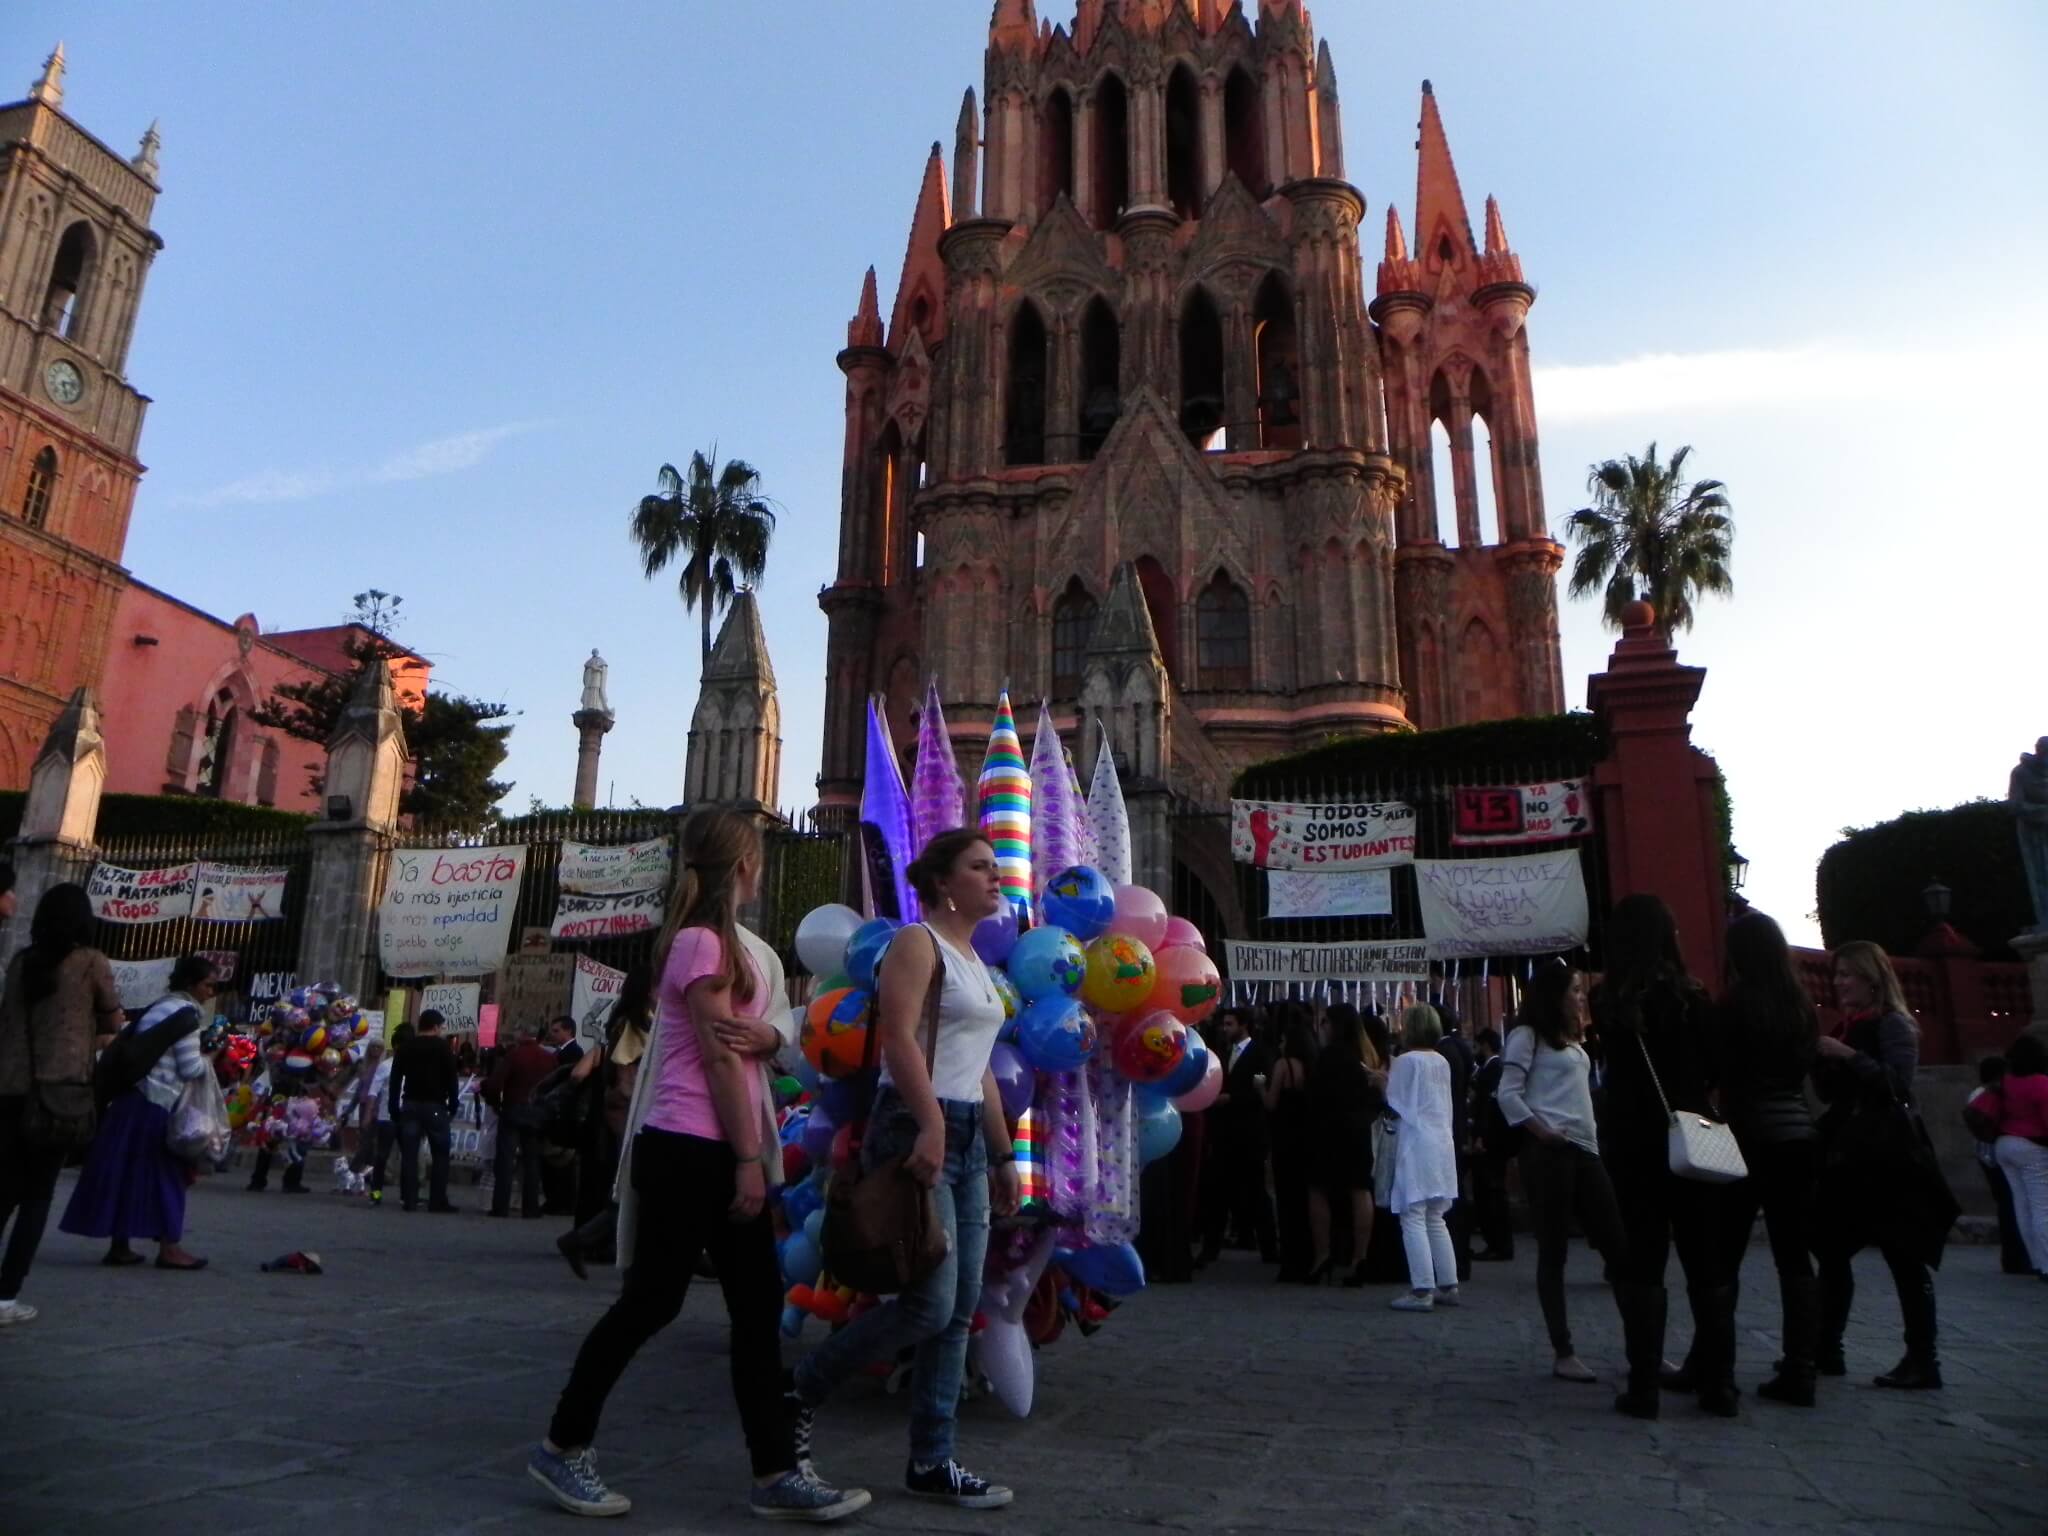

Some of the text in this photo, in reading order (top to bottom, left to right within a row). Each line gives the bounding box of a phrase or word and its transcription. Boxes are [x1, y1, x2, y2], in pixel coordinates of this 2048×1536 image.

[1529, 785, 1547, 797] YA
[1304, 803, 1383, 821] TODOS
[1385, 807, 1414, 821] ALTO
[1464, 794, 1513, 824] 43
[1526, 801, 1549, 814] NO
[1303, 821, 1369, 842] SOMOS
[1303, 836, 1416, 863] ESTUDIANTES
[139, 868, 189, 886] BALAS
[398, 853, 517, 886] Ya basta
[118, 878, 194, 900] MATARNOS
[390, 890, 404, 904] No
[447, 887, 503, 908] injusticia
[613, 888, 666, 911] TODOS
[112, 899, 159, 919] TODOS
[559, 913, 651, 938] AYOTZINAPA
[1235, 945, 1282, 972] BASTA
[424, 987, 464, 1002] TODOS
[591, 977, 614, 993] CON
